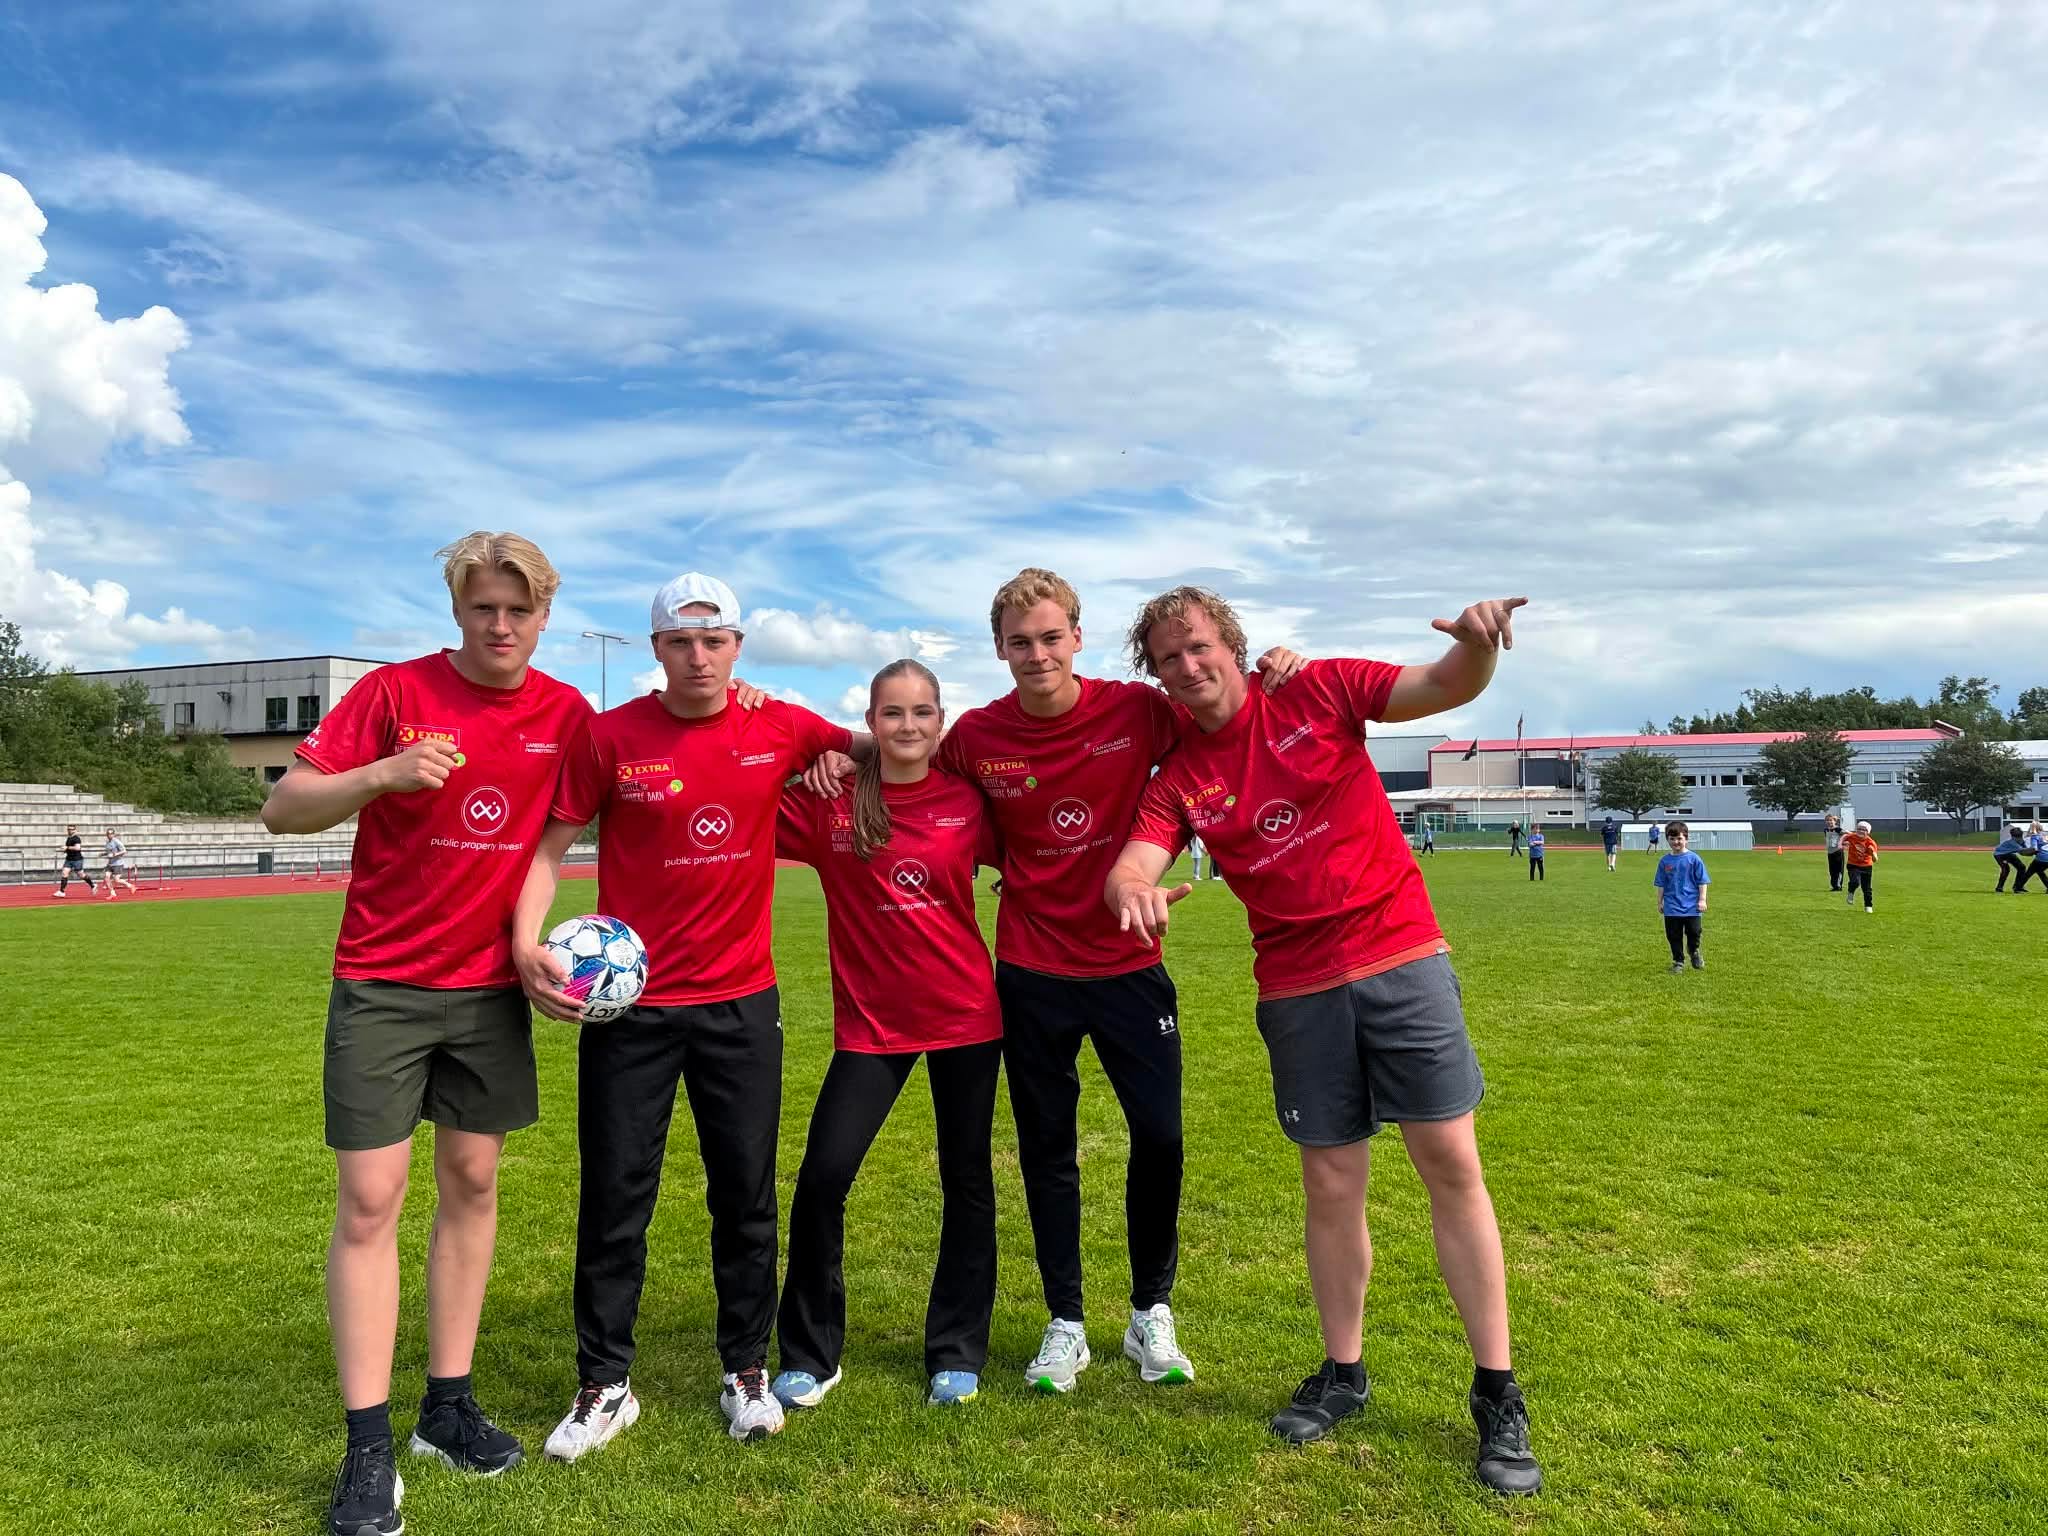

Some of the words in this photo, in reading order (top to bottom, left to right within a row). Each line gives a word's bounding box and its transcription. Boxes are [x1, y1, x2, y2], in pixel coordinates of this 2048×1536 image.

[635, 763, 670, 775] EXTRA
[994, 760, 1026, 772] EXTRA
[430, 838, 459, 848] public
[460, 840, 497, 851] property
[498, 841, 523, 850] invest
[1248, 856, 1272, 874] public
[1272, 837, 1304, 861] property
[1304, 820, 1331, 840] invest
[1036, 848, 1059, 857] public
[664, 856, 692, 868] public
[693, 853, 729, 866] property
[585, 1006, 627, 1018] LECT
